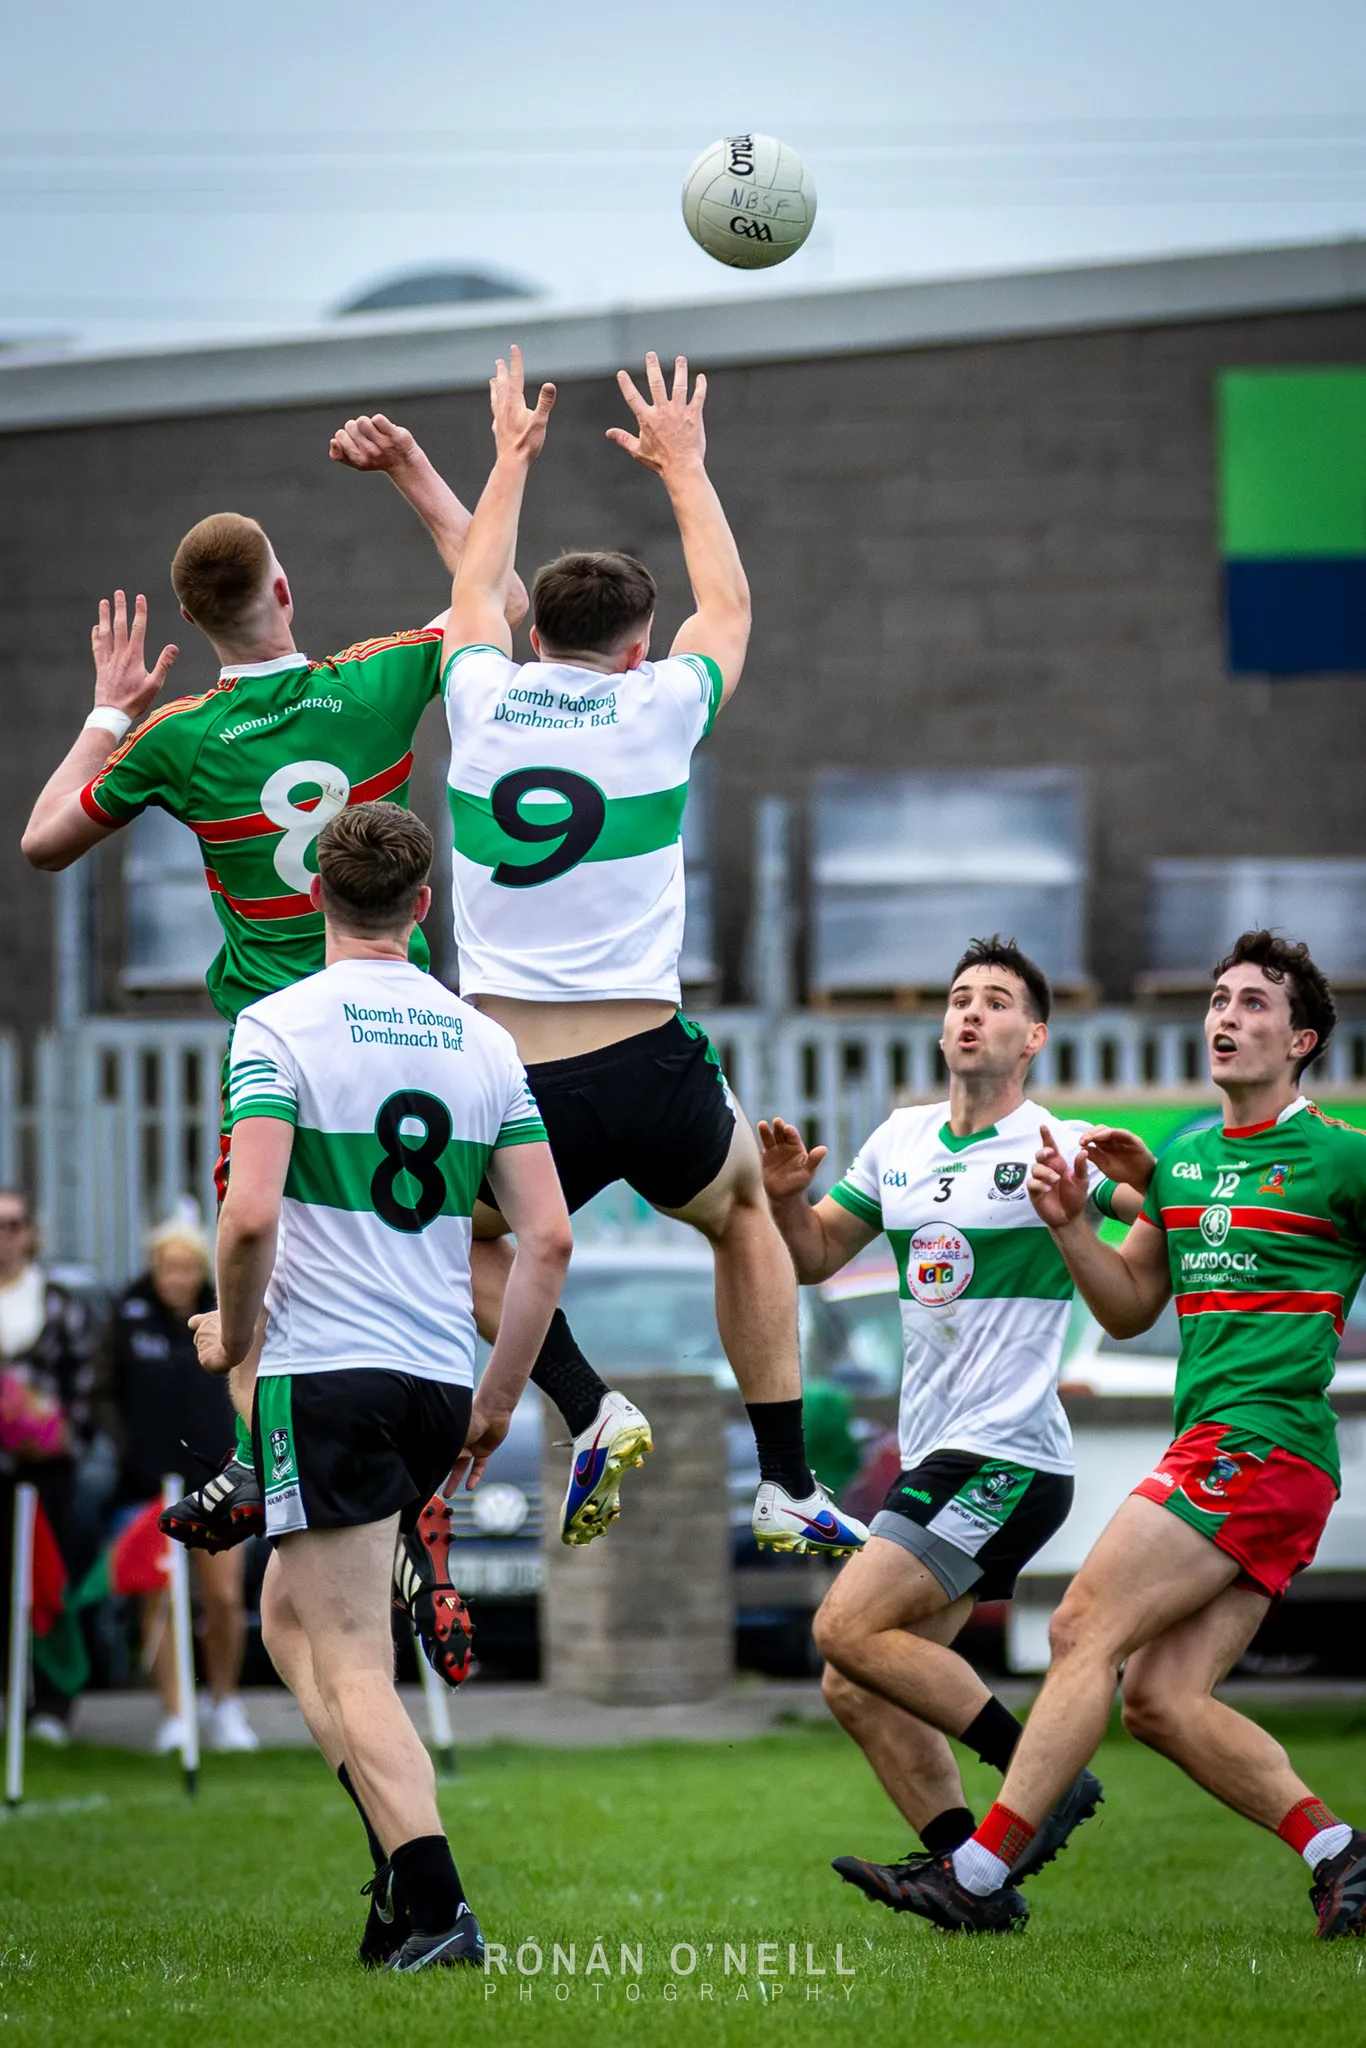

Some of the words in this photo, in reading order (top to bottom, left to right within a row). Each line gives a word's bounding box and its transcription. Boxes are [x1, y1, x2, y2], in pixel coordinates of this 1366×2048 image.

[508, 688, 553, 708] aomh
[494, 702, 585, 729] Domhnach
[260, 760, 350, 894] 8
[490, 766, 606, 889] 9
[343, 1003, 404, 1024] Naomh
[407, 1007, 464, 1036] Pádraig
[350, 1024, 439, 1048] Domhnach
[370, 1088, 453, 1234] 8
[933, 1176, 956, 1203] 3
[1210, 1171, 1241, 1198] 12
[1181, 1252, 1258, 1271] MURDOCK
